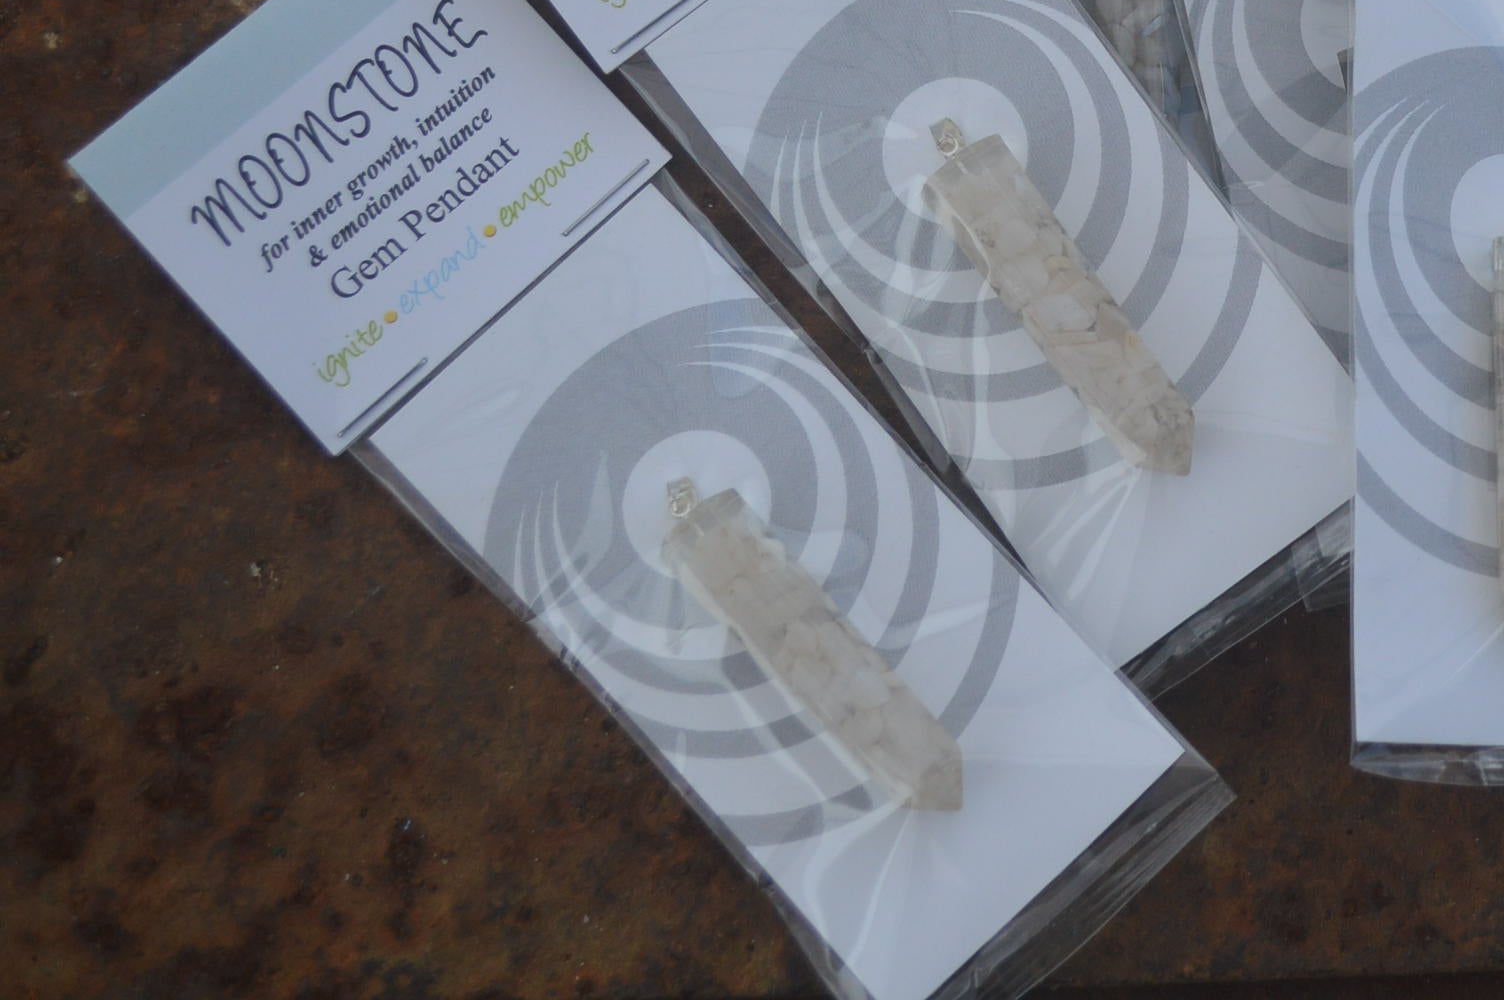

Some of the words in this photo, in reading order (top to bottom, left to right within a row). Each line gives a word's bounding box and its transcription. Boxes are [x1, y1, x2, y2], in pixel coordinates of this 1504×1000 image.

[259, 237, 290, 272] for
[295, 192, 343, 240] inner
[347, 137, 419, 201] growth,
[416, 65, 496, 136] intuition
[308, 244, 328, 267] &
[332, 168, 421, 251] emotional
[423, 105, 493, 172] balance
[311, 320, 385, 387] ignite
[399, 226, 485, 314] expand
[499, 132, 596, 228] empower
[330, 236, 408, 299] Gem
[398, 136, 520, 241] Pendant
